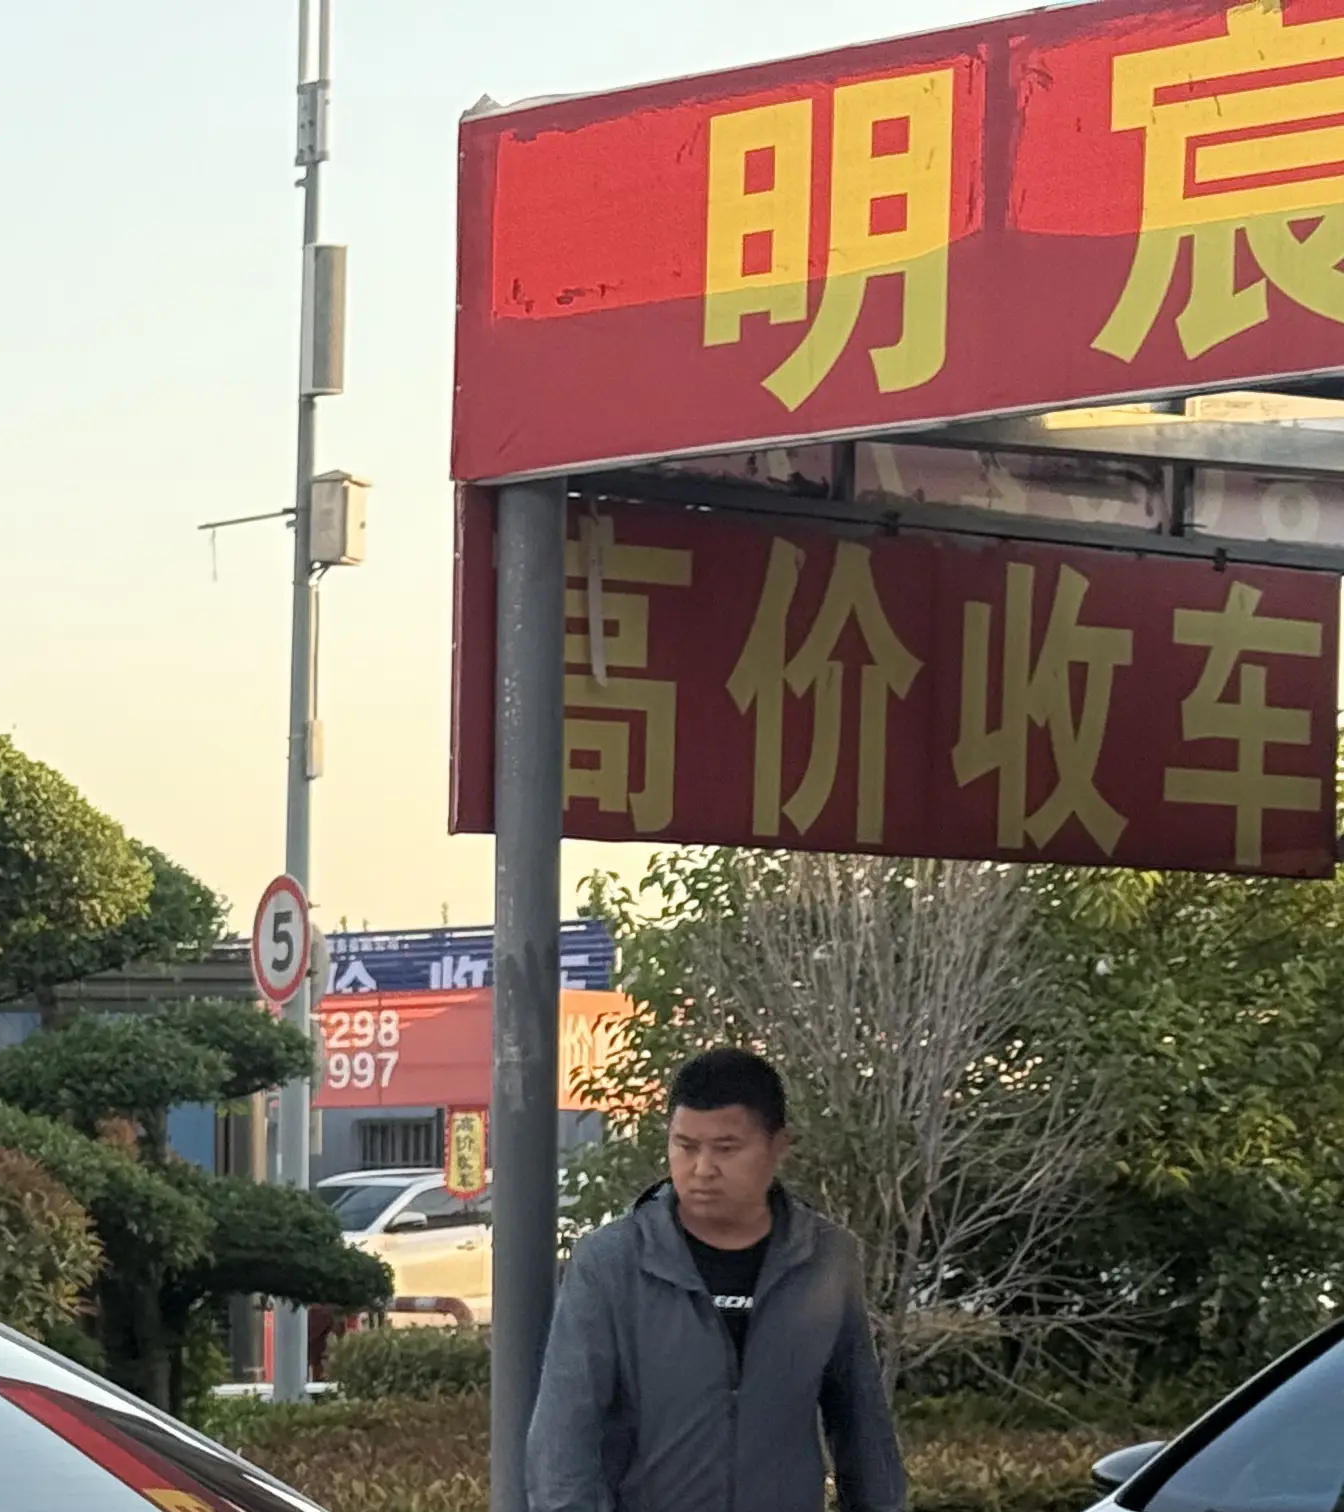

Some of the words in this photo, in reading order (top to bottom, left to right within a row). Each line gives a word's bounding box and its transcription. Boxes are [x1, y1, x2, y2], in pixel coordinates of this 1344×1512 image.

[702, 0, 1344, 412] 明宸
[564, 514, 1323, 868] 高价收车
[272, 910, 294, 972] 5
[308, 1010, 400, 1048] 298
[328, 1051, 400, 1089] 997
